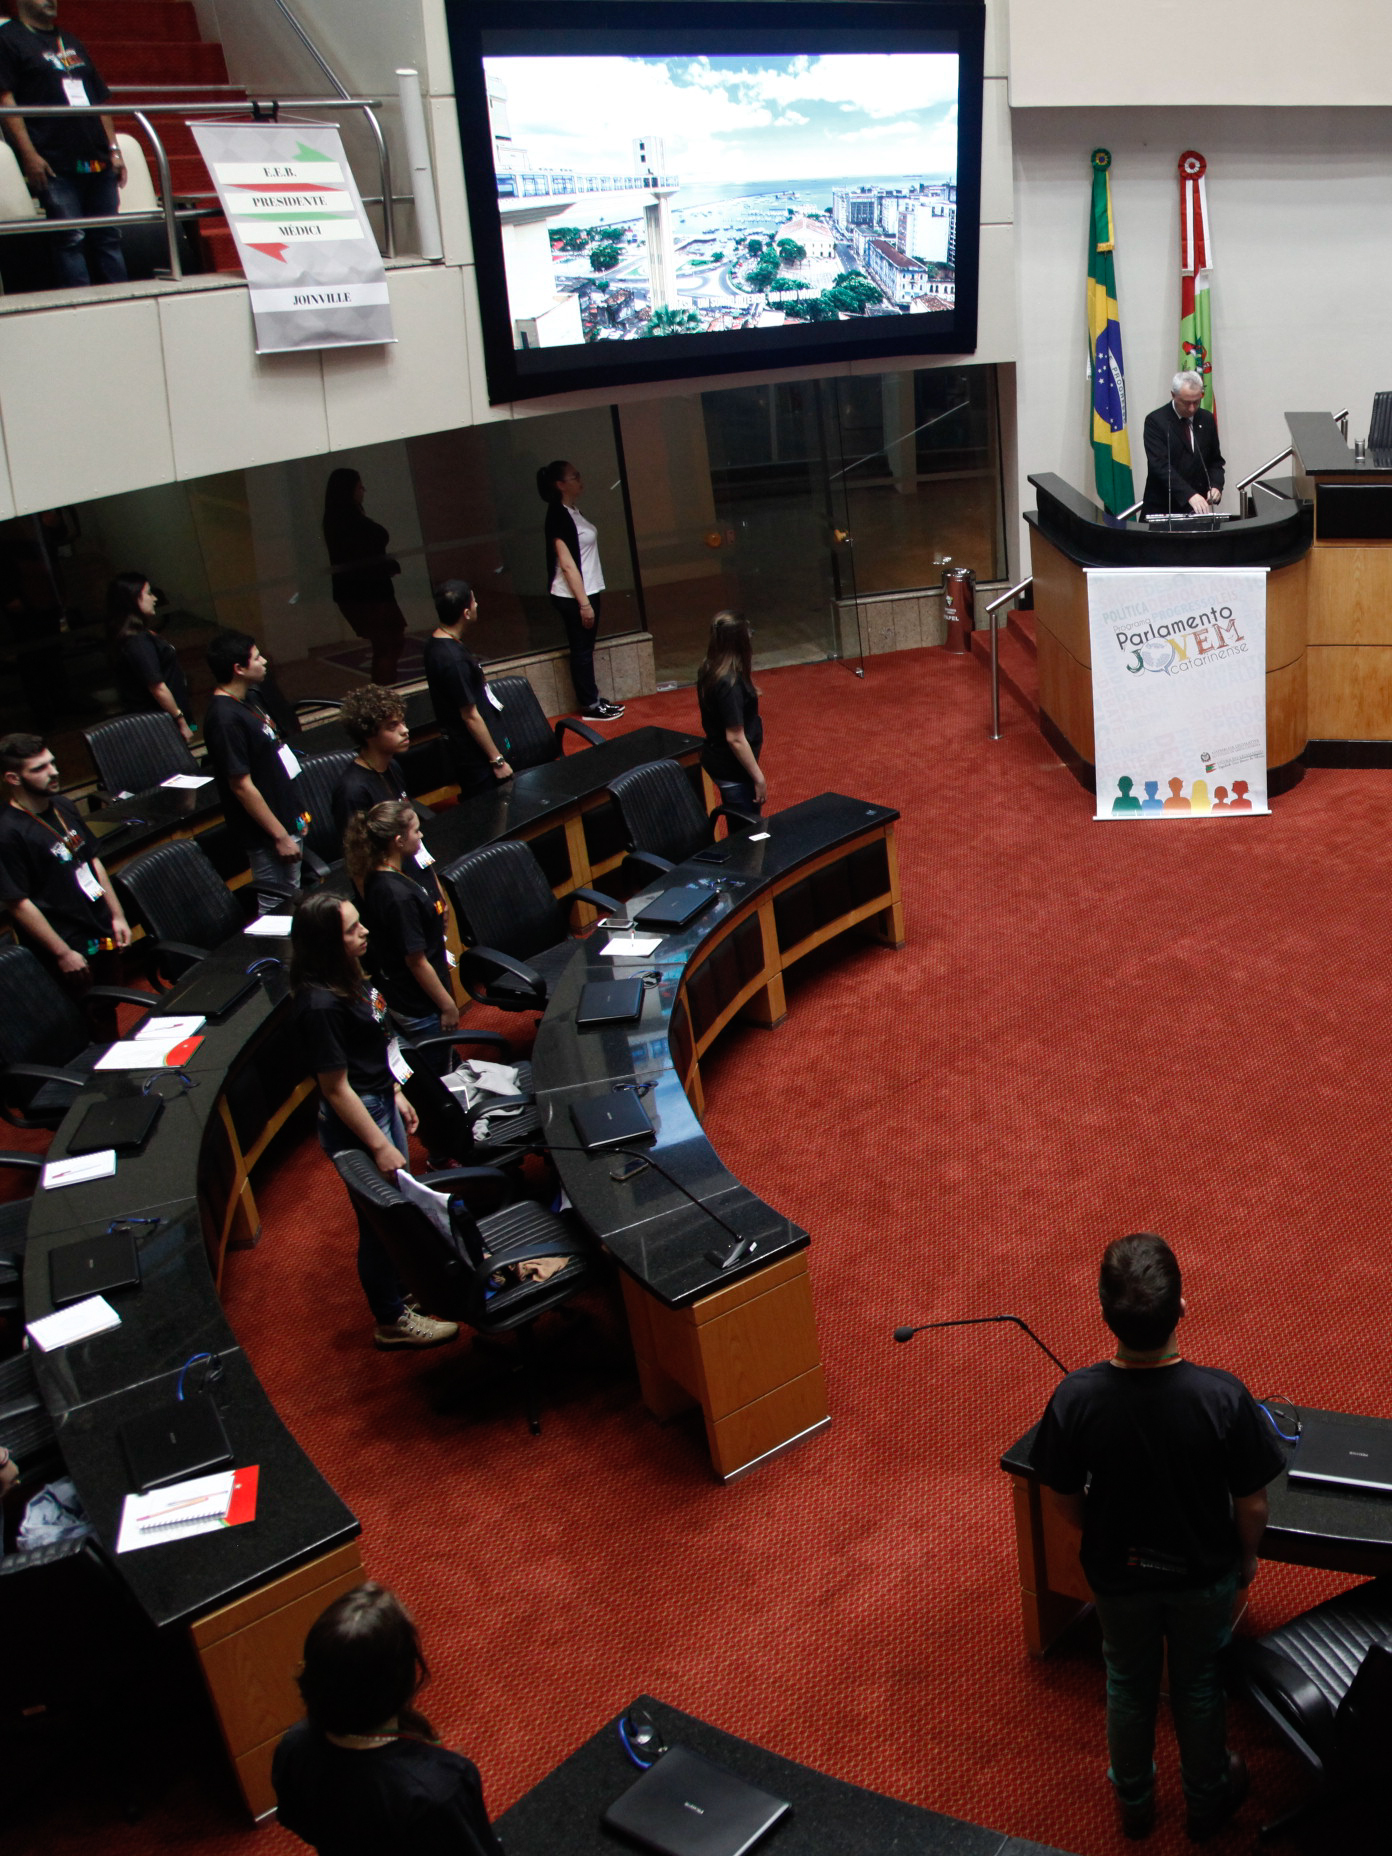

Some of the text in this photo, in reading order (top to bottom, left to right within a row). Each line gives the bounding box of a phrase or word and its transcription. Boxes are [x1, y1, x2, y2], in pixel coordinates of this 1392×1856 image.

[263, 167, 297, 178] E.E.B.
[252, 195, 328, 208] PRESIDENTE
[278, 224, 322, 236] MÉDICI
[293, 292, 352, 306] JOINVILLE
[1113, 618, 1152, 633] Programa
[1116, 606, 1233, 651] Parlamento
[1126, 618, 1245, 677] JOVEM
[1170, 642, 1249, 675] catarinense
